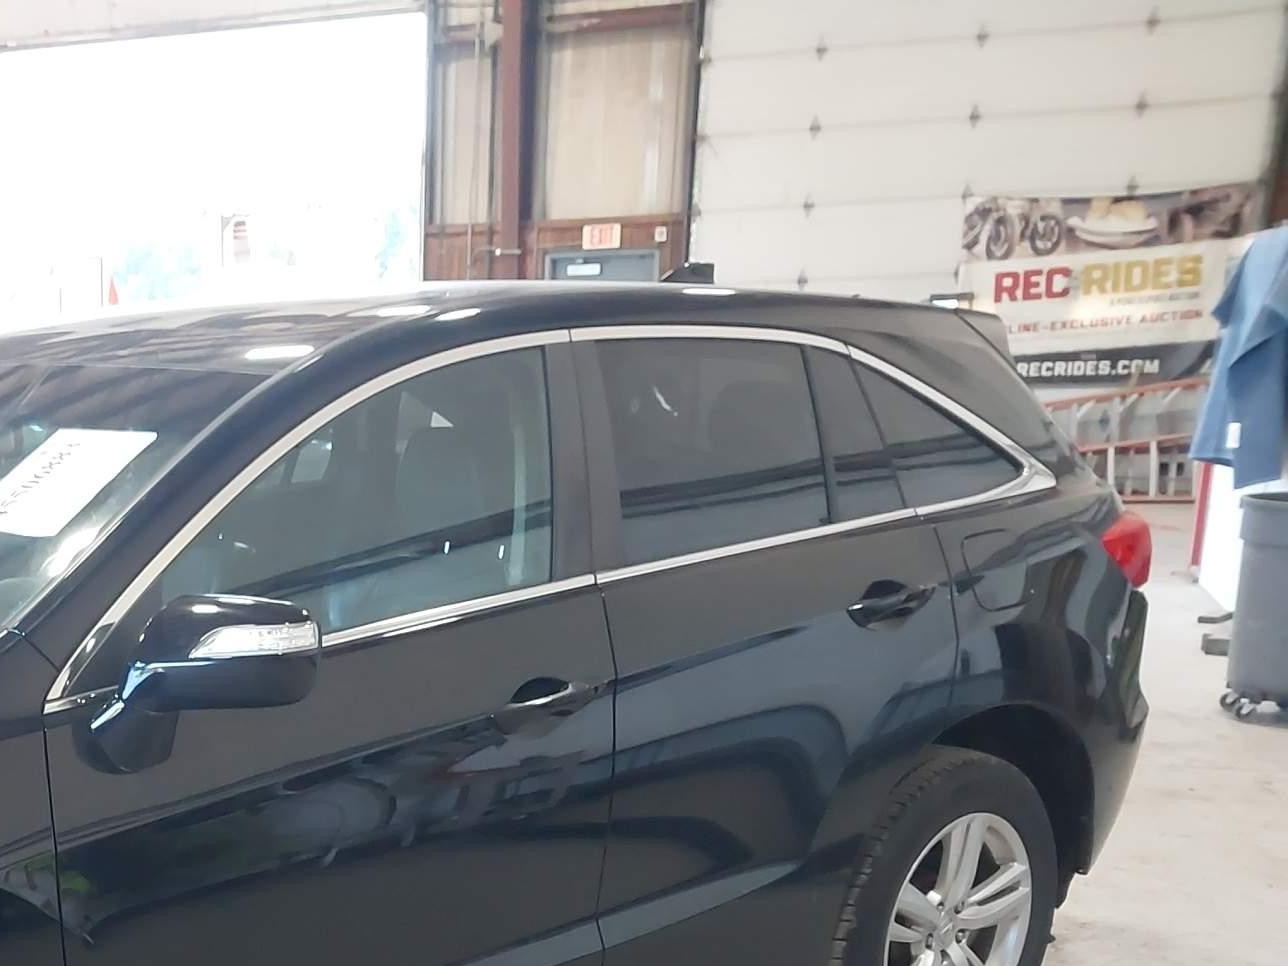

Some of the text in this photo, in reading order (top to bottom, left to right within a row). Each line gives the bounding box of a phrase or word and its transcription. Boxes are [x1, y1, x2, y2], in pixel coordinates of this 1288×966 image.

[994, 255, 1203, 304] REC RIDES
[1008, 309, 1204, 334] LINE-EXCLUSIVE AUCTION
